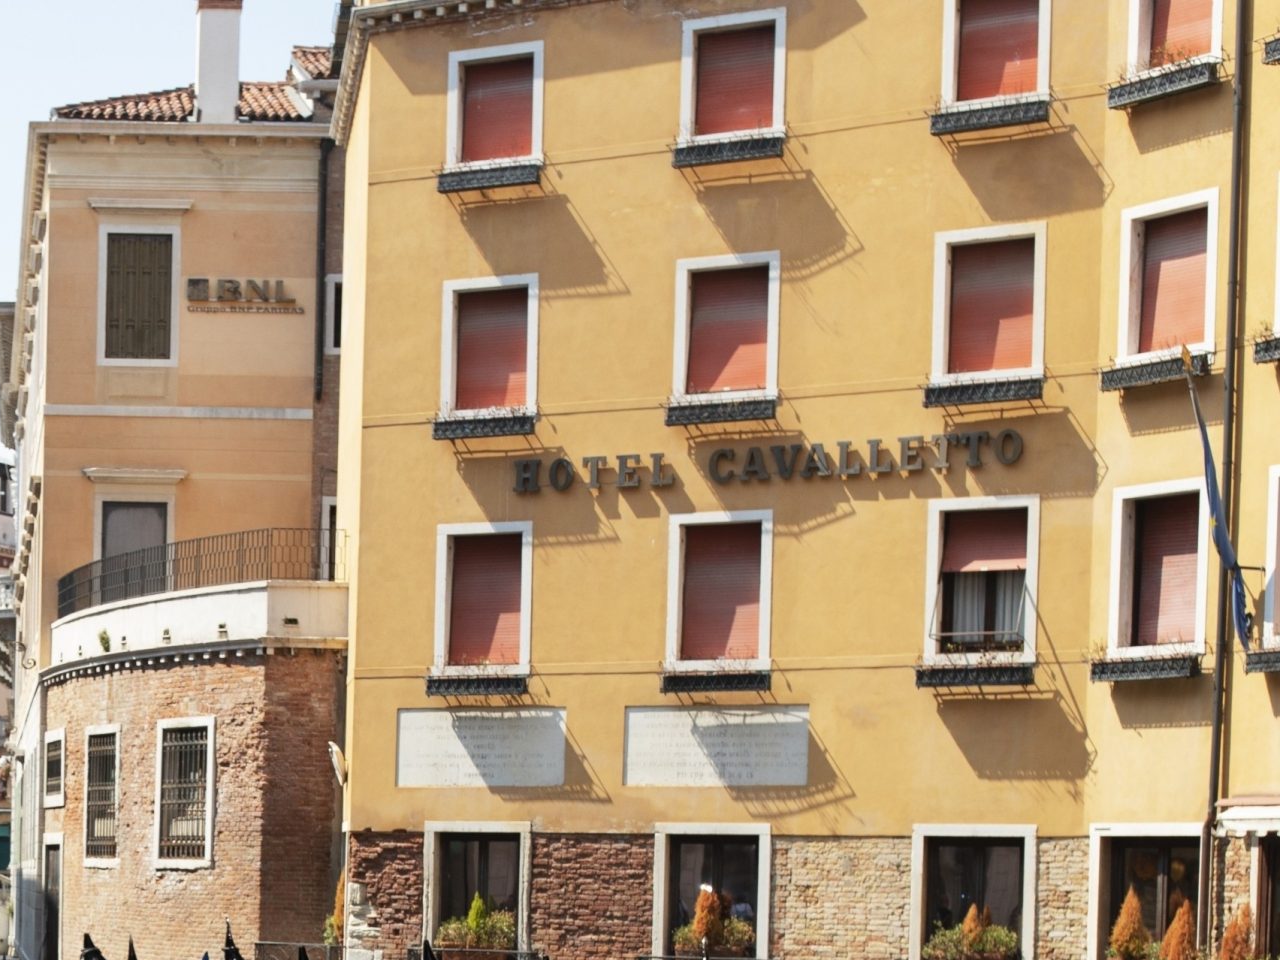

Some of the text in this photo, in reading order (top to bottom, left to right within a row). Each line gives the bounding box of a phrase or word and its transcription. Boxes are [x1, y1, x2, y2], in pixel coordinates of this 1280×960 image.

[217, 279, 296, 303] BNL
[230, 306, 254, 314] BNP
[256, 306, 305, 315] PARIBAS
[512, 429, 1024, 494] HOTEL CAVALLETTO
